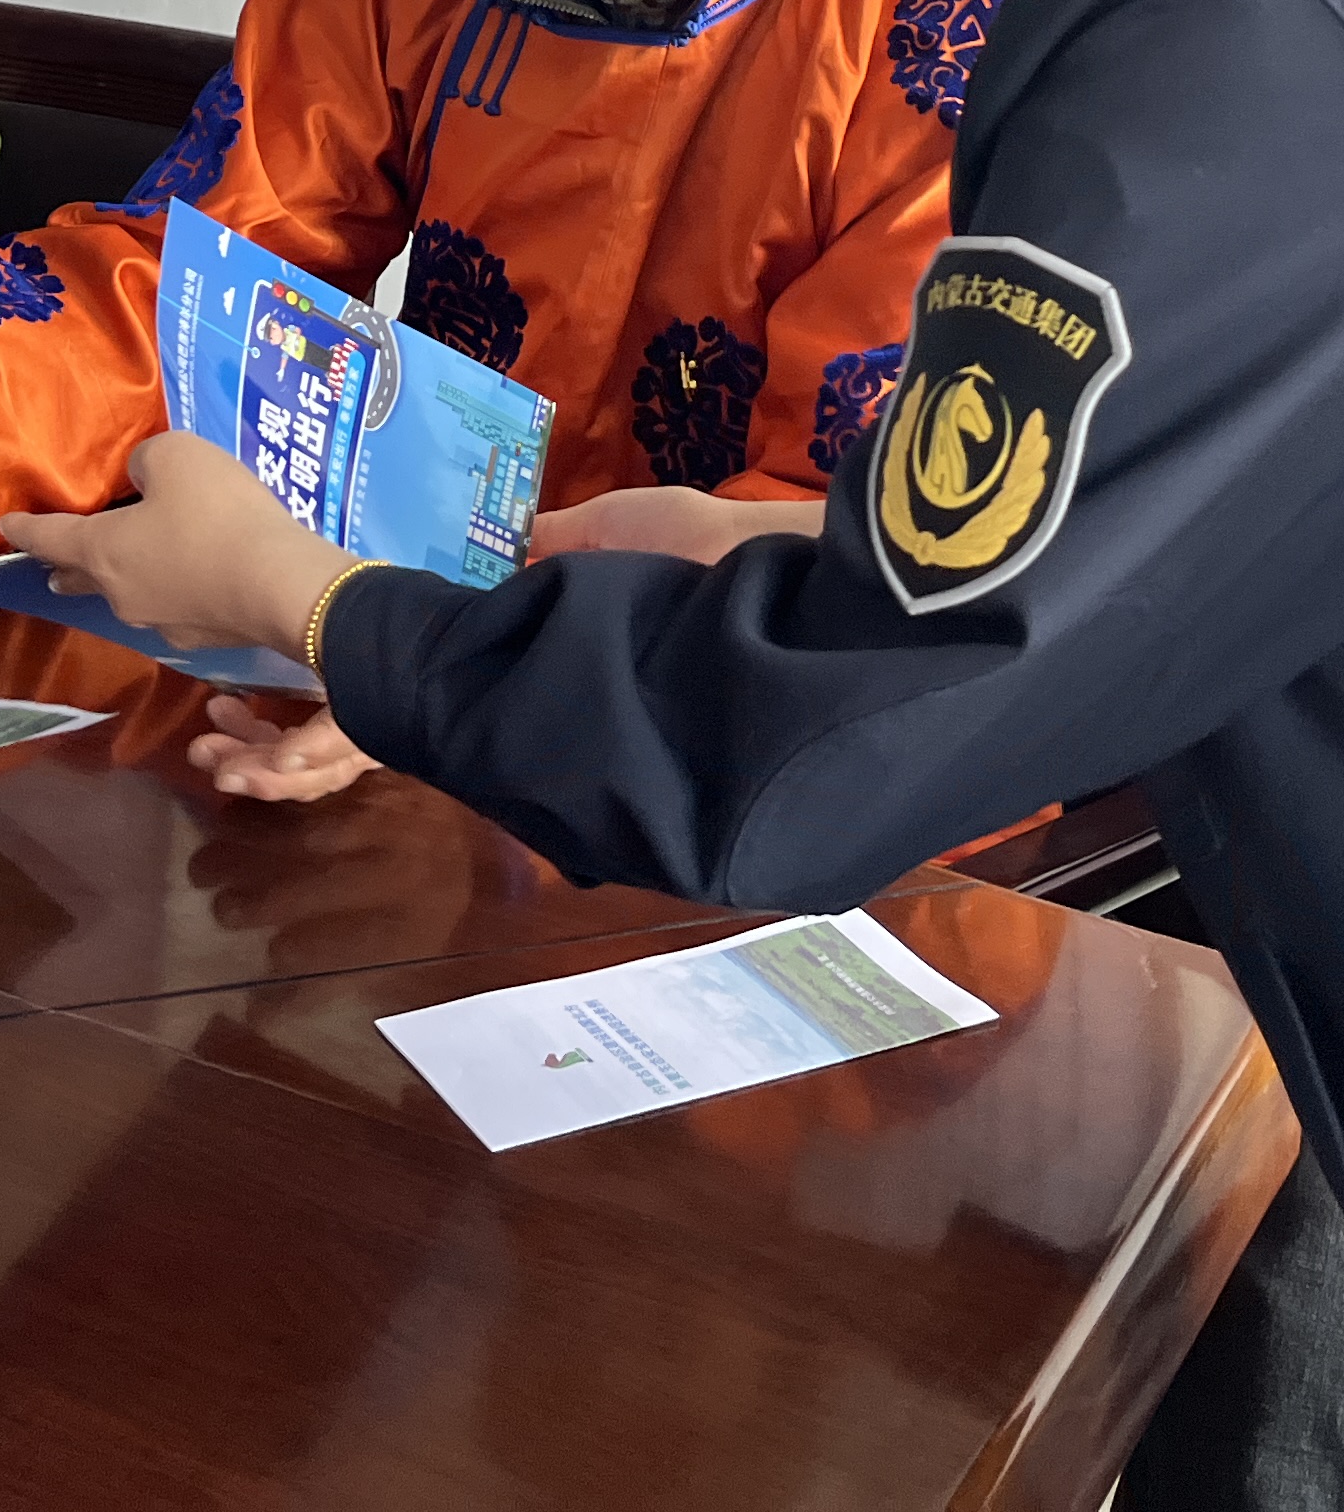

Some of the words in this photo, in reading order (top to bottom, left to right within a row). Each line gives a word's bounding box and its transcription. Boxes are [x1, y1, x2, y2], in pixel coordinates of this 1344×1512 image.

[256, 397, 292, 496] 交规
[287, 371, 333, 532] 文明出行
